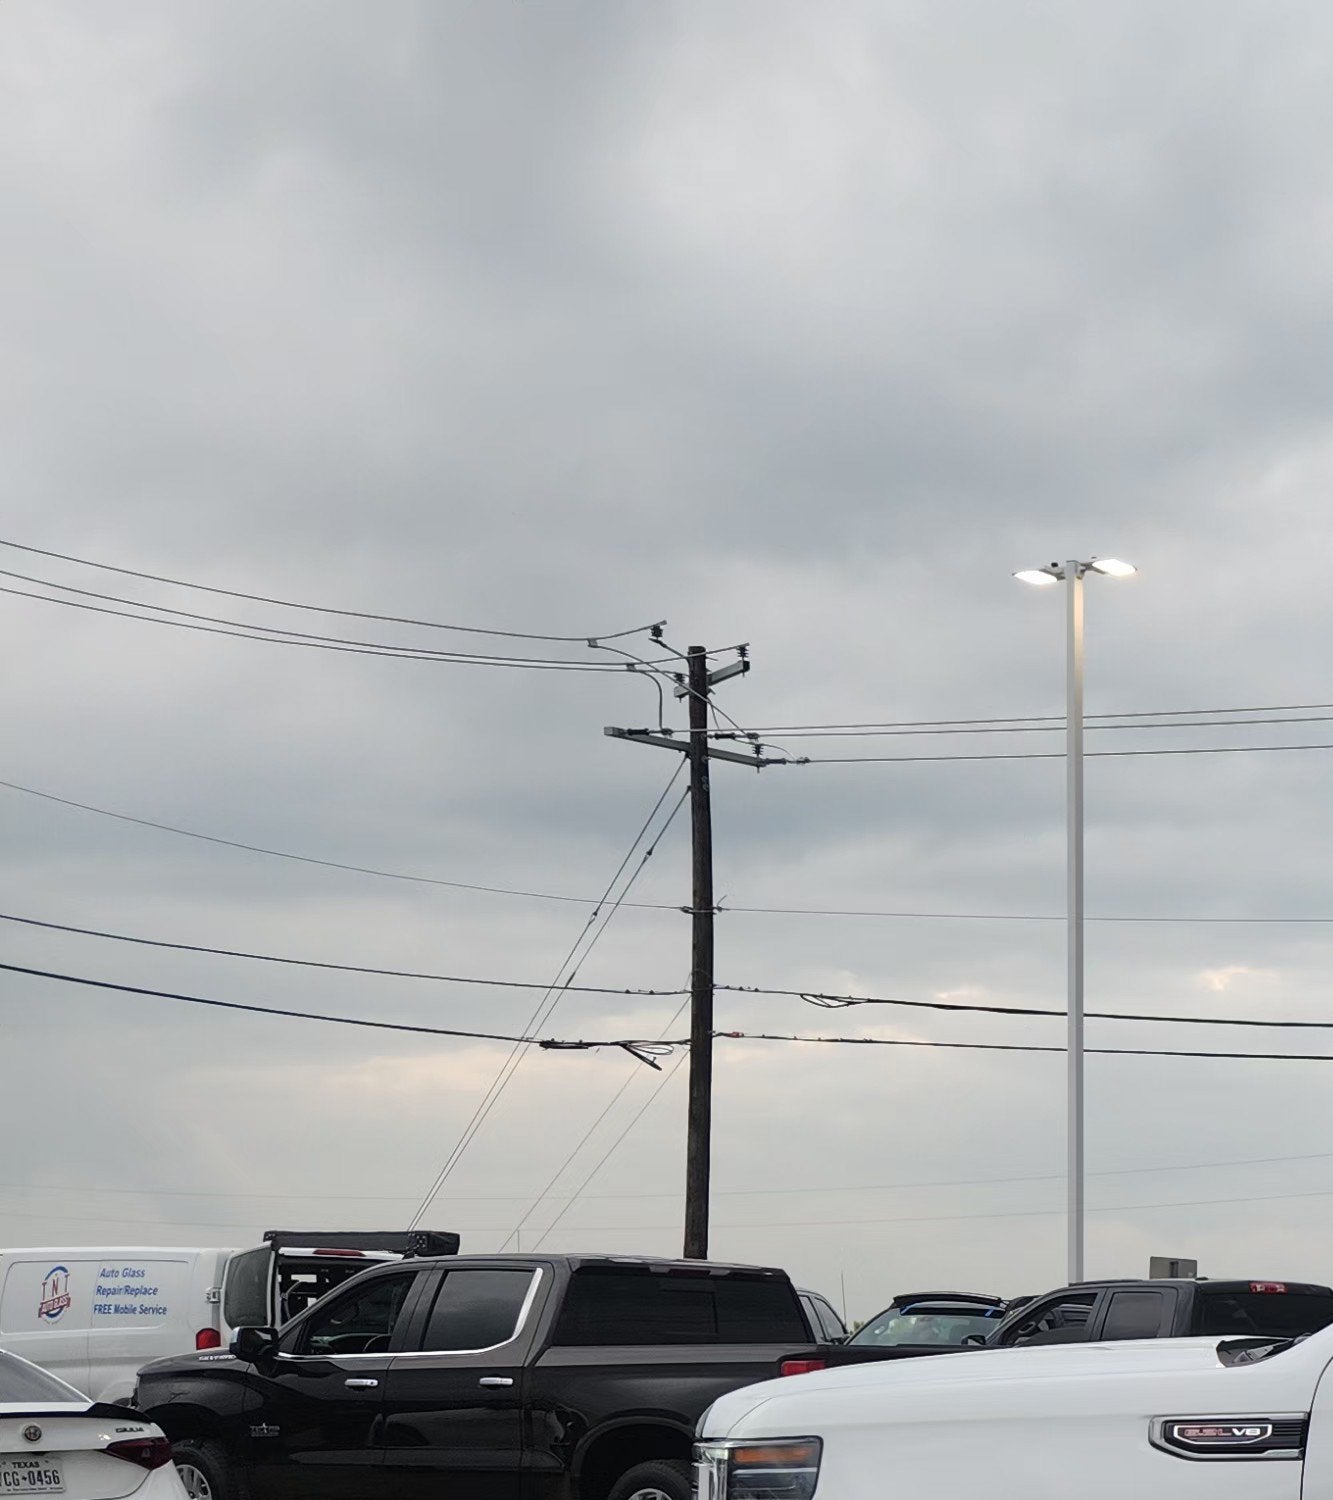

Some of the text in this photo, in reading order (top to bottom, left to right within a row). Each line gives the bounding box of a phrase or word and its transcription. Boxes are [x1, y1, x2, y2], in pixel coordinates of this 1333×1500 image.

[100, 1267, 145, 1278] Auto Glass
[94, 1304, 167, 1315] FREE Mobile Service
[12, 1461, 40, 1469] TEXAS
